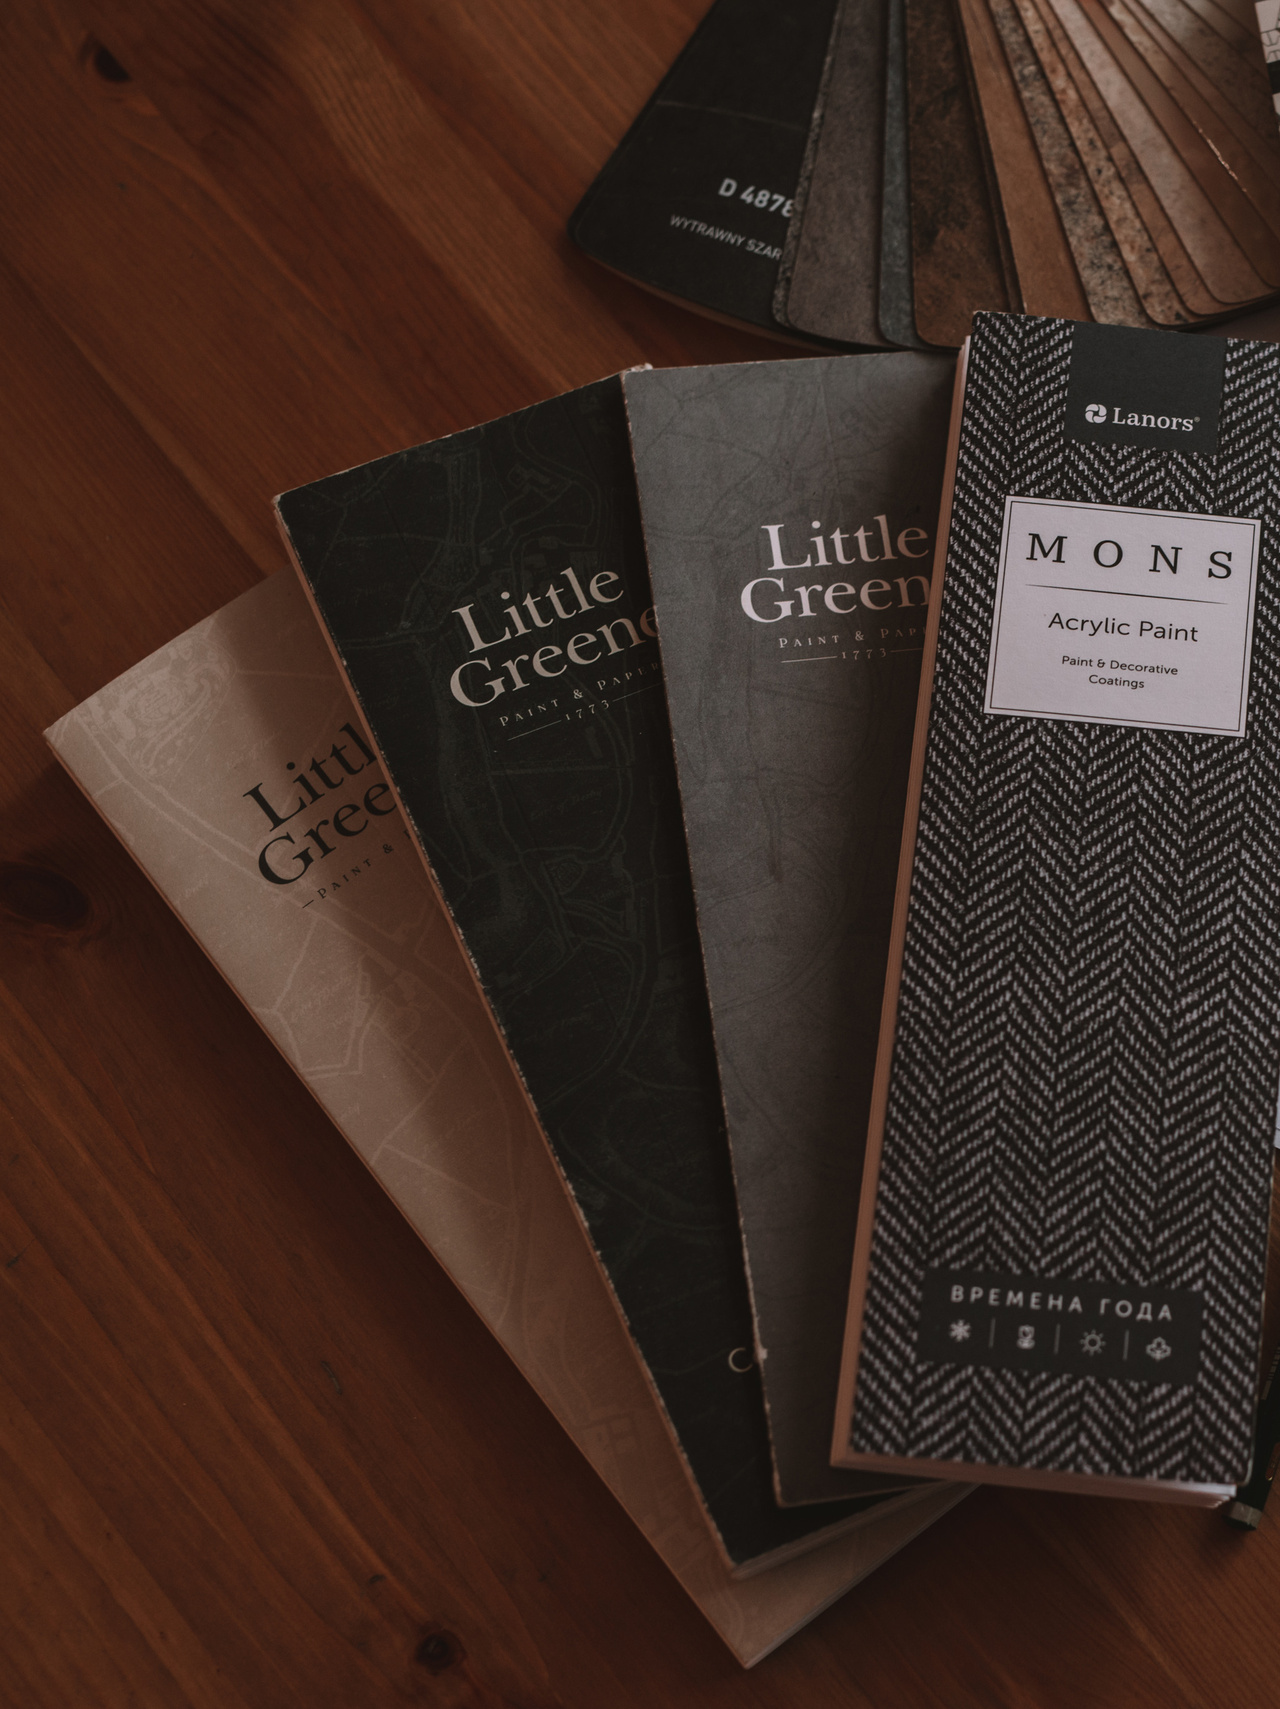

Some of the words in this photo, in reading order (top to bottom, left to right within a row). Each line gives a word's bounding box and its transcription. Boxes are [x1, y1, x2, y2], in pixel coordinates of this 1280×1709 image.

[718, 178, 737, 196] D
[670, 215, 745, 246] WYTRAWNY
[745, 238, 781, 259] SZAR
[761, 516, 929, 572] Little
[1025, 531, 1234, 581] MONS
[452, 565, 625, 654] Little
[1047, 612, 1130, 636] Acrylic
[1139, 620, 1198, 642] Paint
[450, 604, 659, 708] Greene
[778, 634, 839, 648] PAINT
[854, 630, 863, 641] &
[1061, 655, 1093, 667] Paint
[1096, 658, 1105, 668] &
[1109, 659, 1178, 675] Decorative
[1088, 674, 1144, 689] Coatings
[499, 698, 557, 726] PAINT
[573, 688, 583, 699] &
[316, 858, 370, 899] PAINT
[382, 843, 393, 853] &
[951, 1284, 1082, 1312] ВРЕМЕНА
[1099, 1298, 1171, 1321] ГОДА
